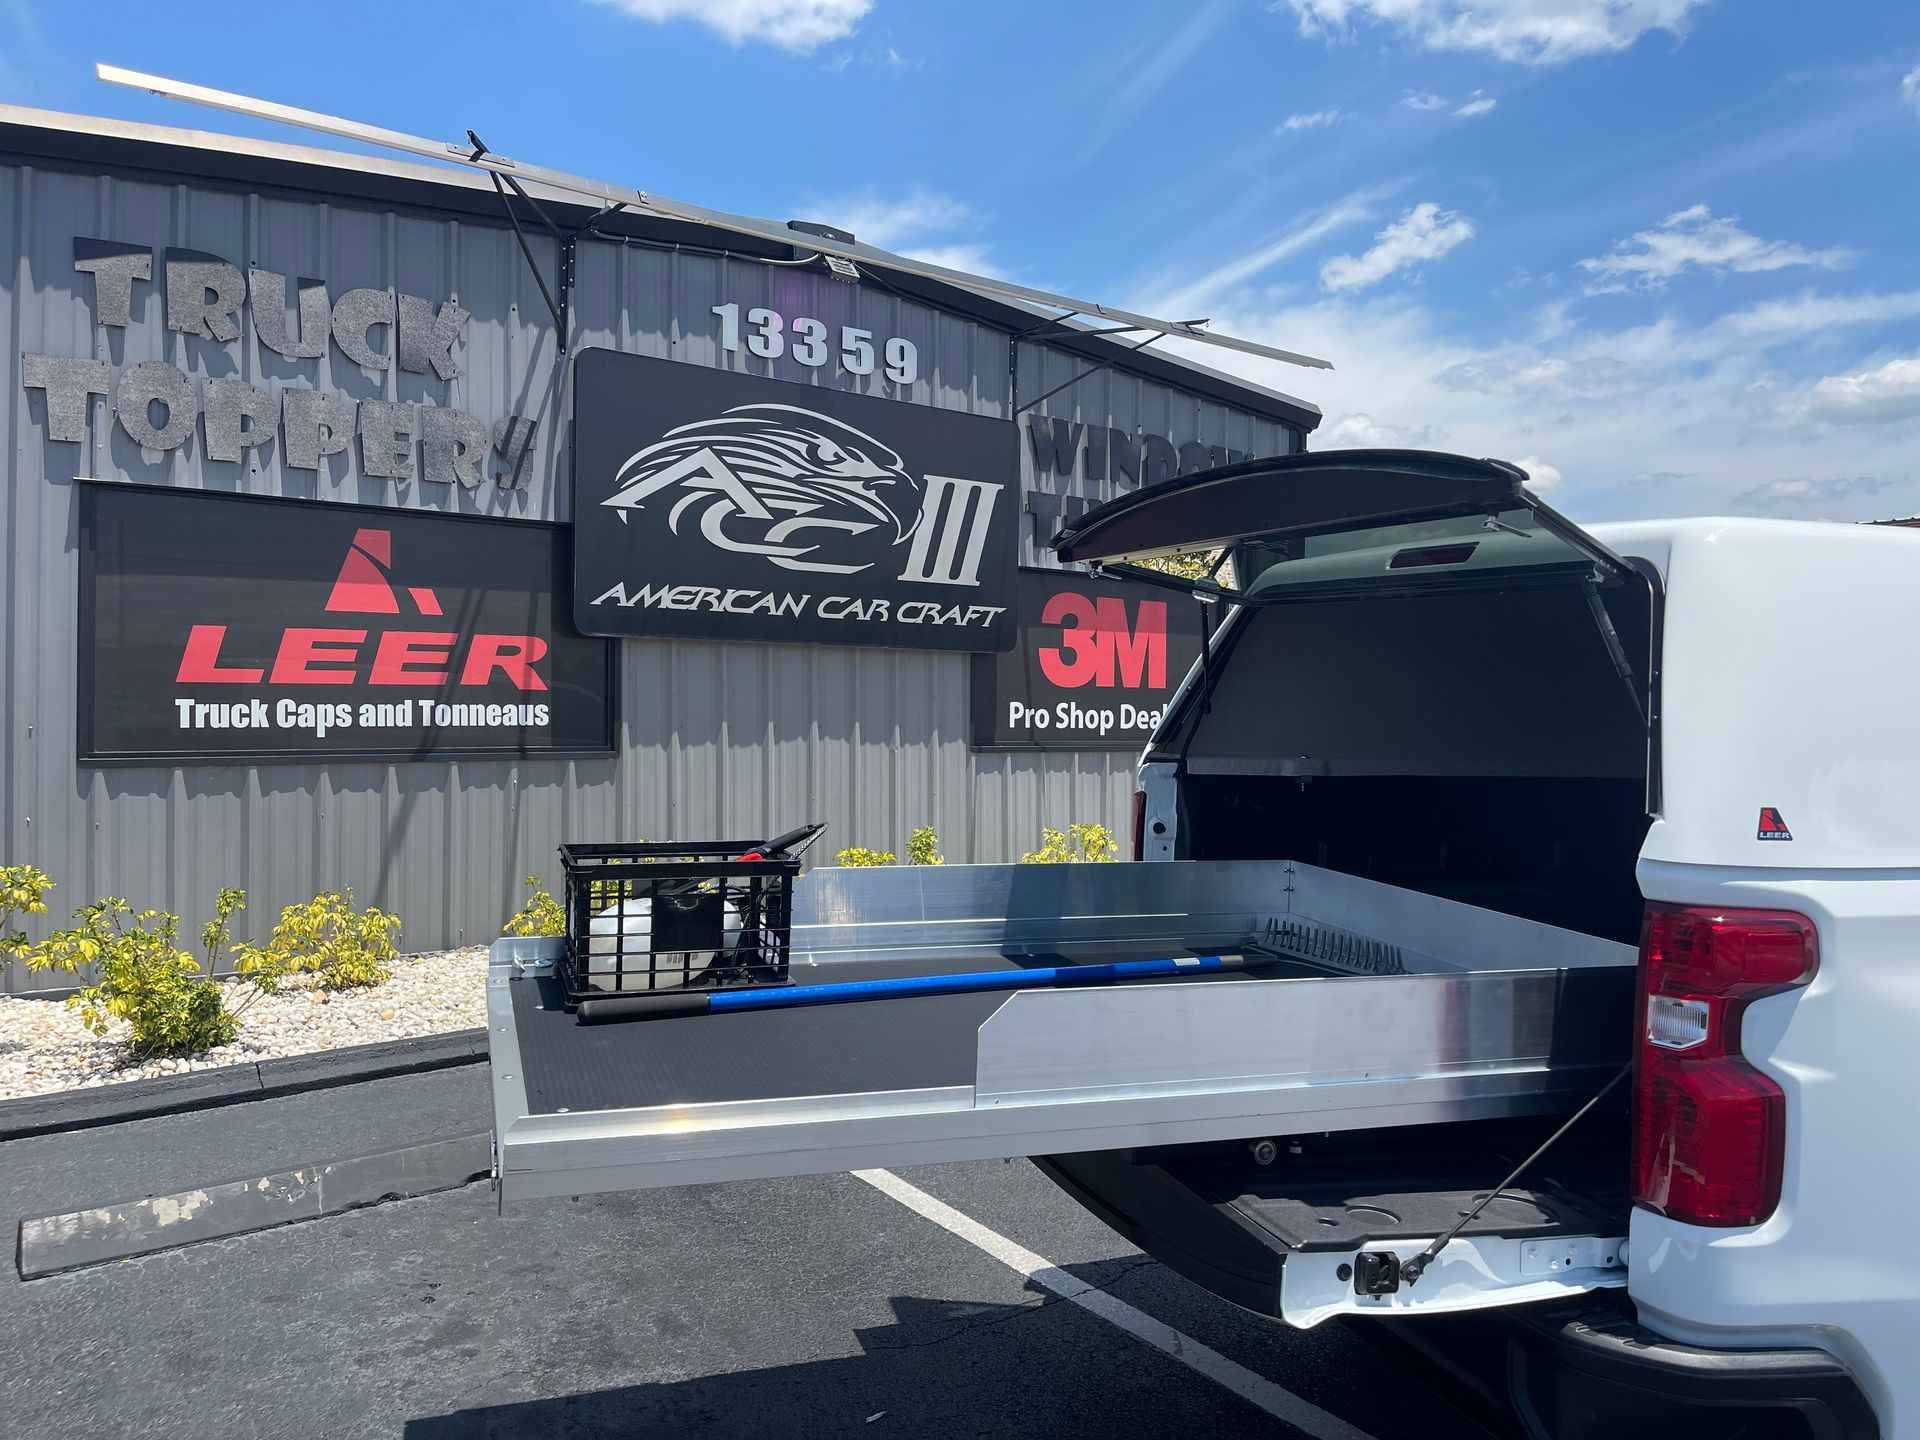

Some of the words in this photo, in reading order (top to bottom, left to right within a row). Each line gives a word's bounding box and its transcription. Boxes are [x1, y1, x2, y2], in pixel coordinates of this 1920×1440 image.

[74, 236, 470, 381] TRUCK
[712, 303, 918, 384] 13359
[22, 352, 537, 489] TOPPERS
[590, 581, 811, 618] AMERICAN
[816, 596, 890, 622] CAR
[896, 601, 1007, 628] CRAFT
[176, 625, 549, 691] LEER
[1038, 592, 1167, 689] 3M
[175, 698, 269, 729] Truck
[276, 699, 352, 738] Caps
[359, 700, 412, 727] and
[418, 699, 549, 727] Tonneaus
[1009, 702, 1049, 728] Pro
[1056, 703, 1114, 735] Shop
[1759, 831, 1790, 839] LEER
